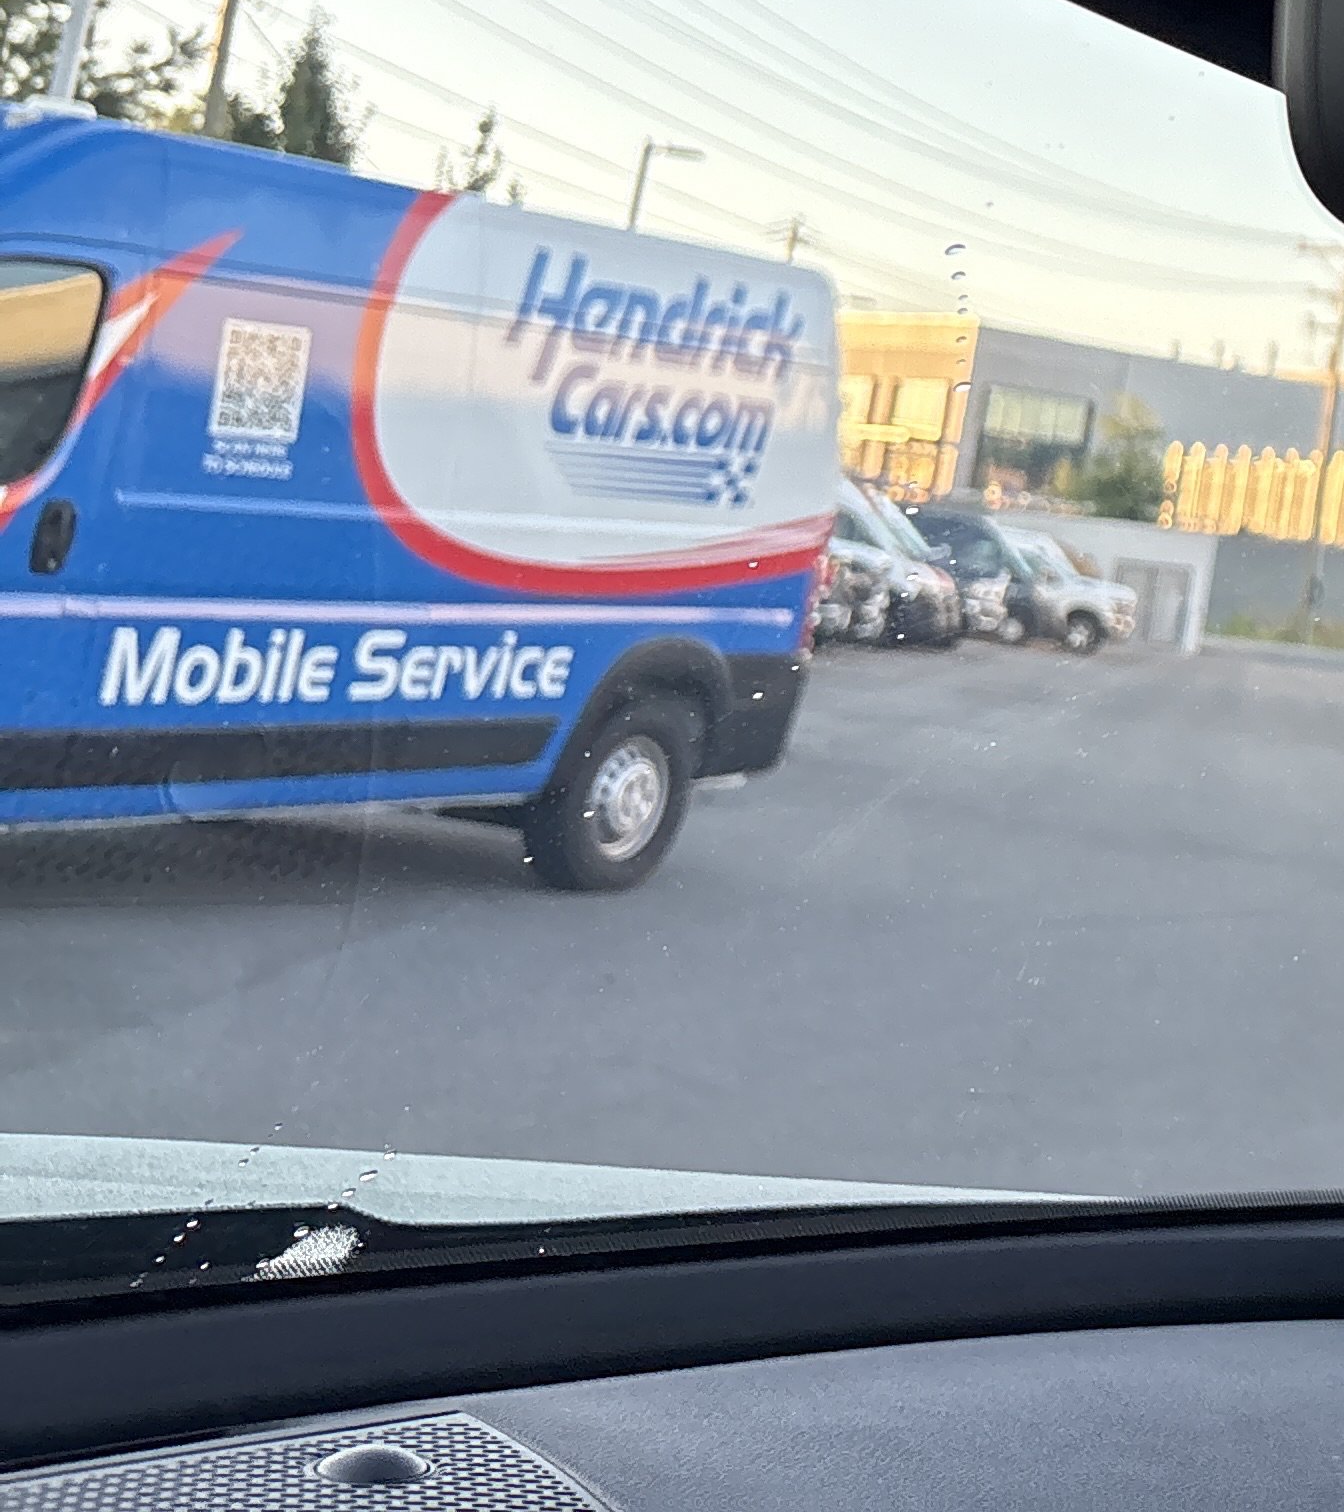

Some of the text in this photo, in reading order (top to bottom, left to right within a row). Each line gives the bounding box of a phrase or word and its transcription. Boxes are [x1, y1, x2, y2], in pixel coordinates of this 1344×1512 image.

[504, 245, 806, 382] Hendrick
[549, 360, 775, 452] Cars.com
[98, 625, 575, 707] Mobile Service
